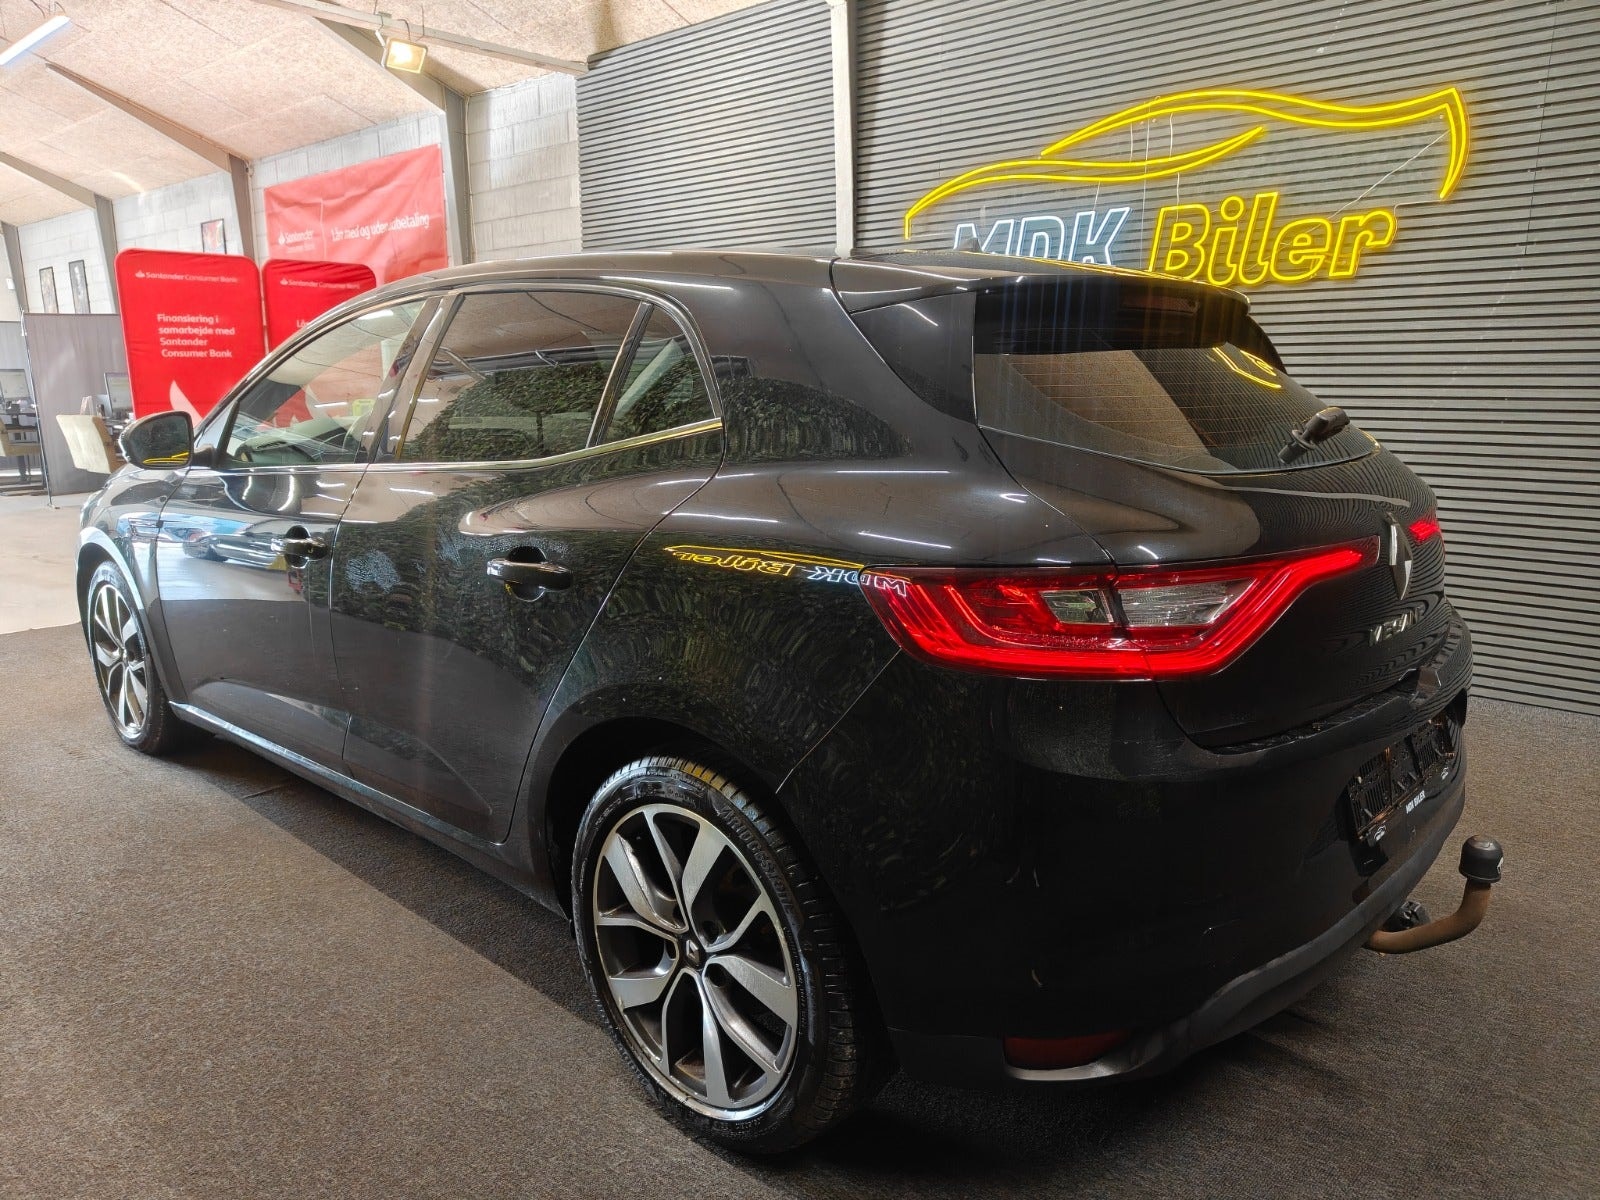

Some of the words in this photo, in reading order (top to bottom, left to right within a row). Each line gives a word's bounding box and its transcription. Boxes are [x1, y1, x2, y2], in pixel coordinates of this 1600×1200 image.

[360, 226, 371, 240] og
[953, 207, 1133, 266] MDK
[1149, 192, 1394, 286] Biler
[145, 272, 184, 281] Santander
[185, 274, 220, 282] Consumer
[156, 313, 214, 325] Finansiering
[158, 326, 214, 336] samarbejde
[215, 327, 235, 335] med
[159, 337, 208, 346] Santander
[161, 349, 207, 358] Consumer
[209, 349, 233, 358] Bank
